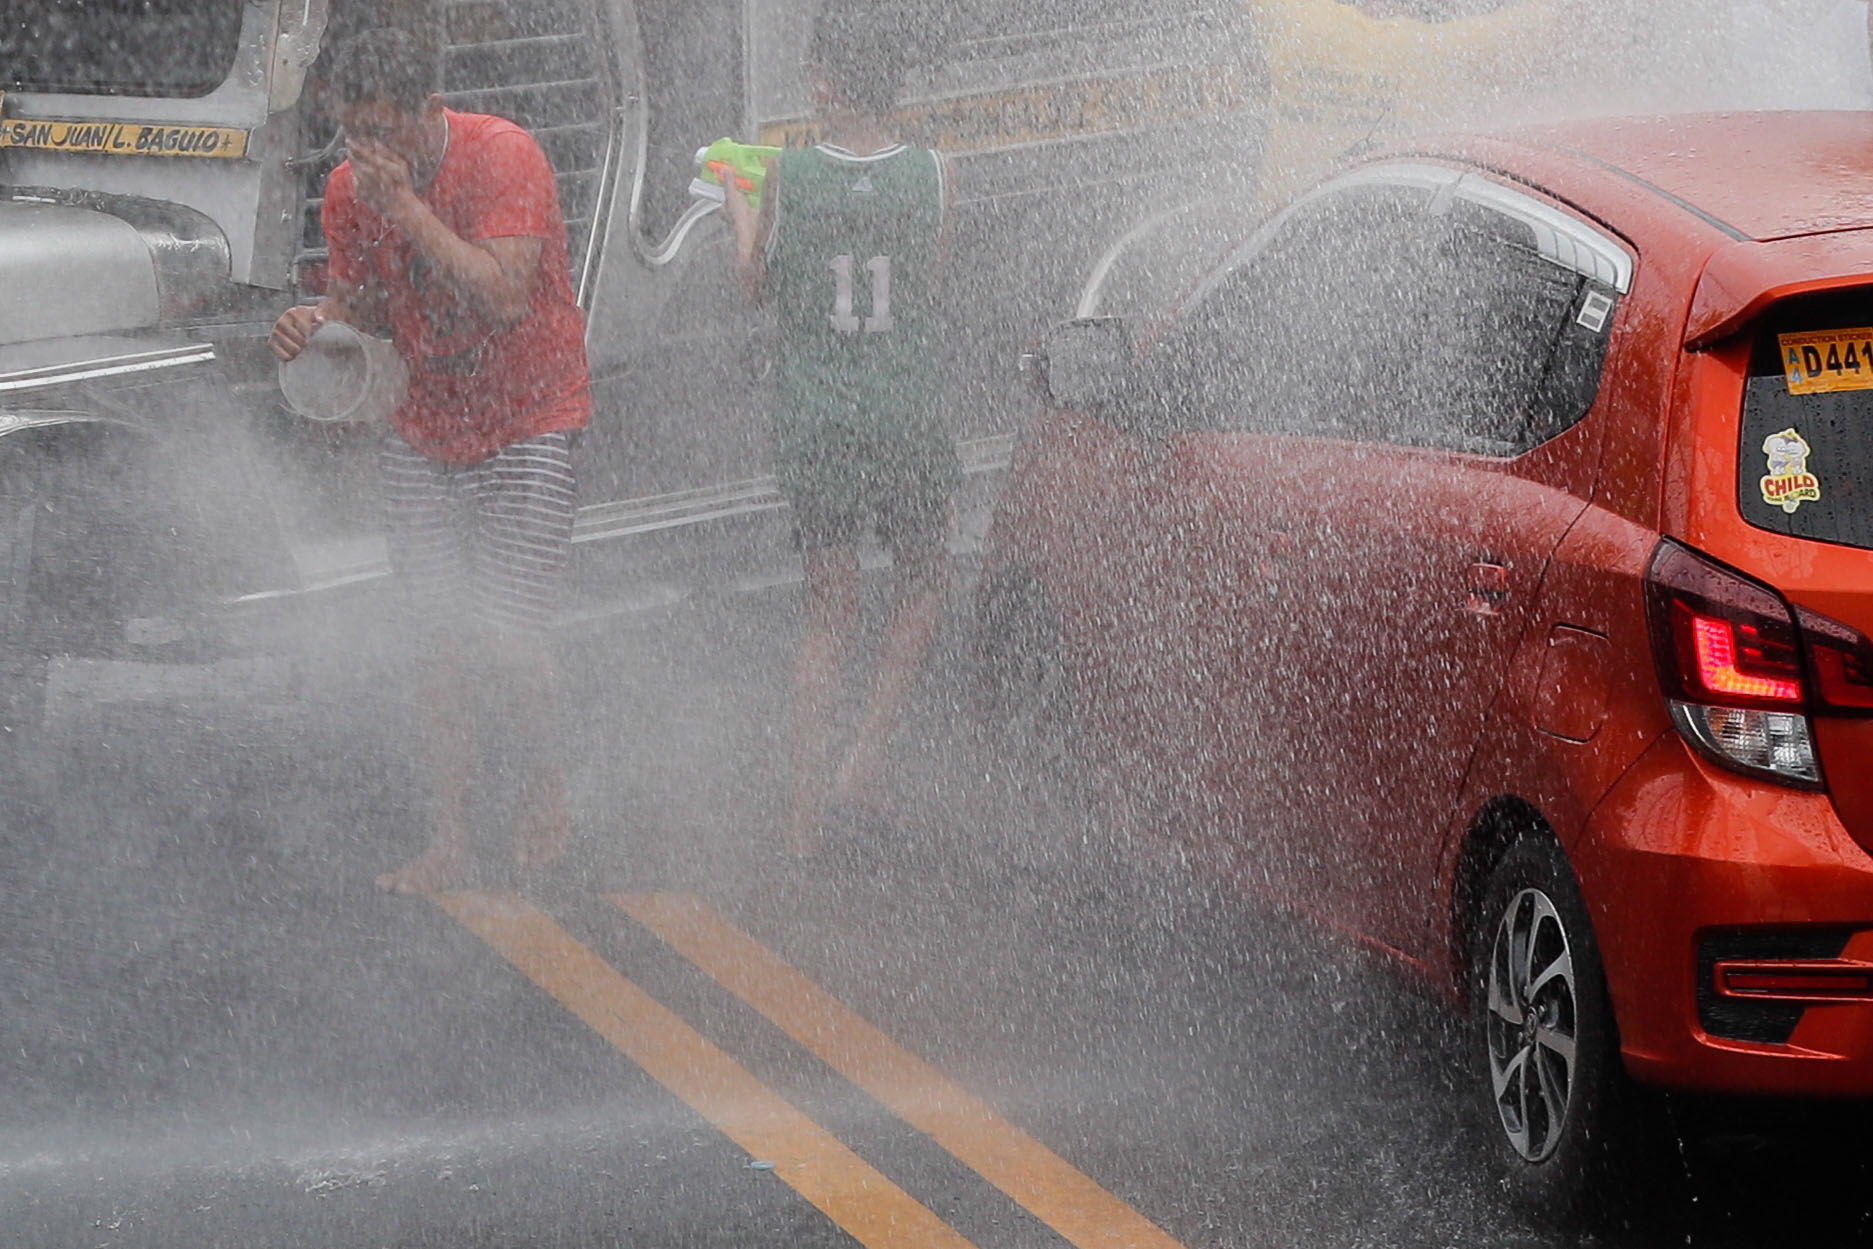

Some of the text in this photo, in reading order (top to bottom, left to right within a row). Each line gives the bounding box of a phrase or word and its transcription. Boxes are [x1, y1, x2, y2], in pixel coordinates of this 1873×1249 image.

[9, 122, 52, 146] SAN
[829, 254, 893, 332] 11
[1764, 475, 1815, 497] CHILD
